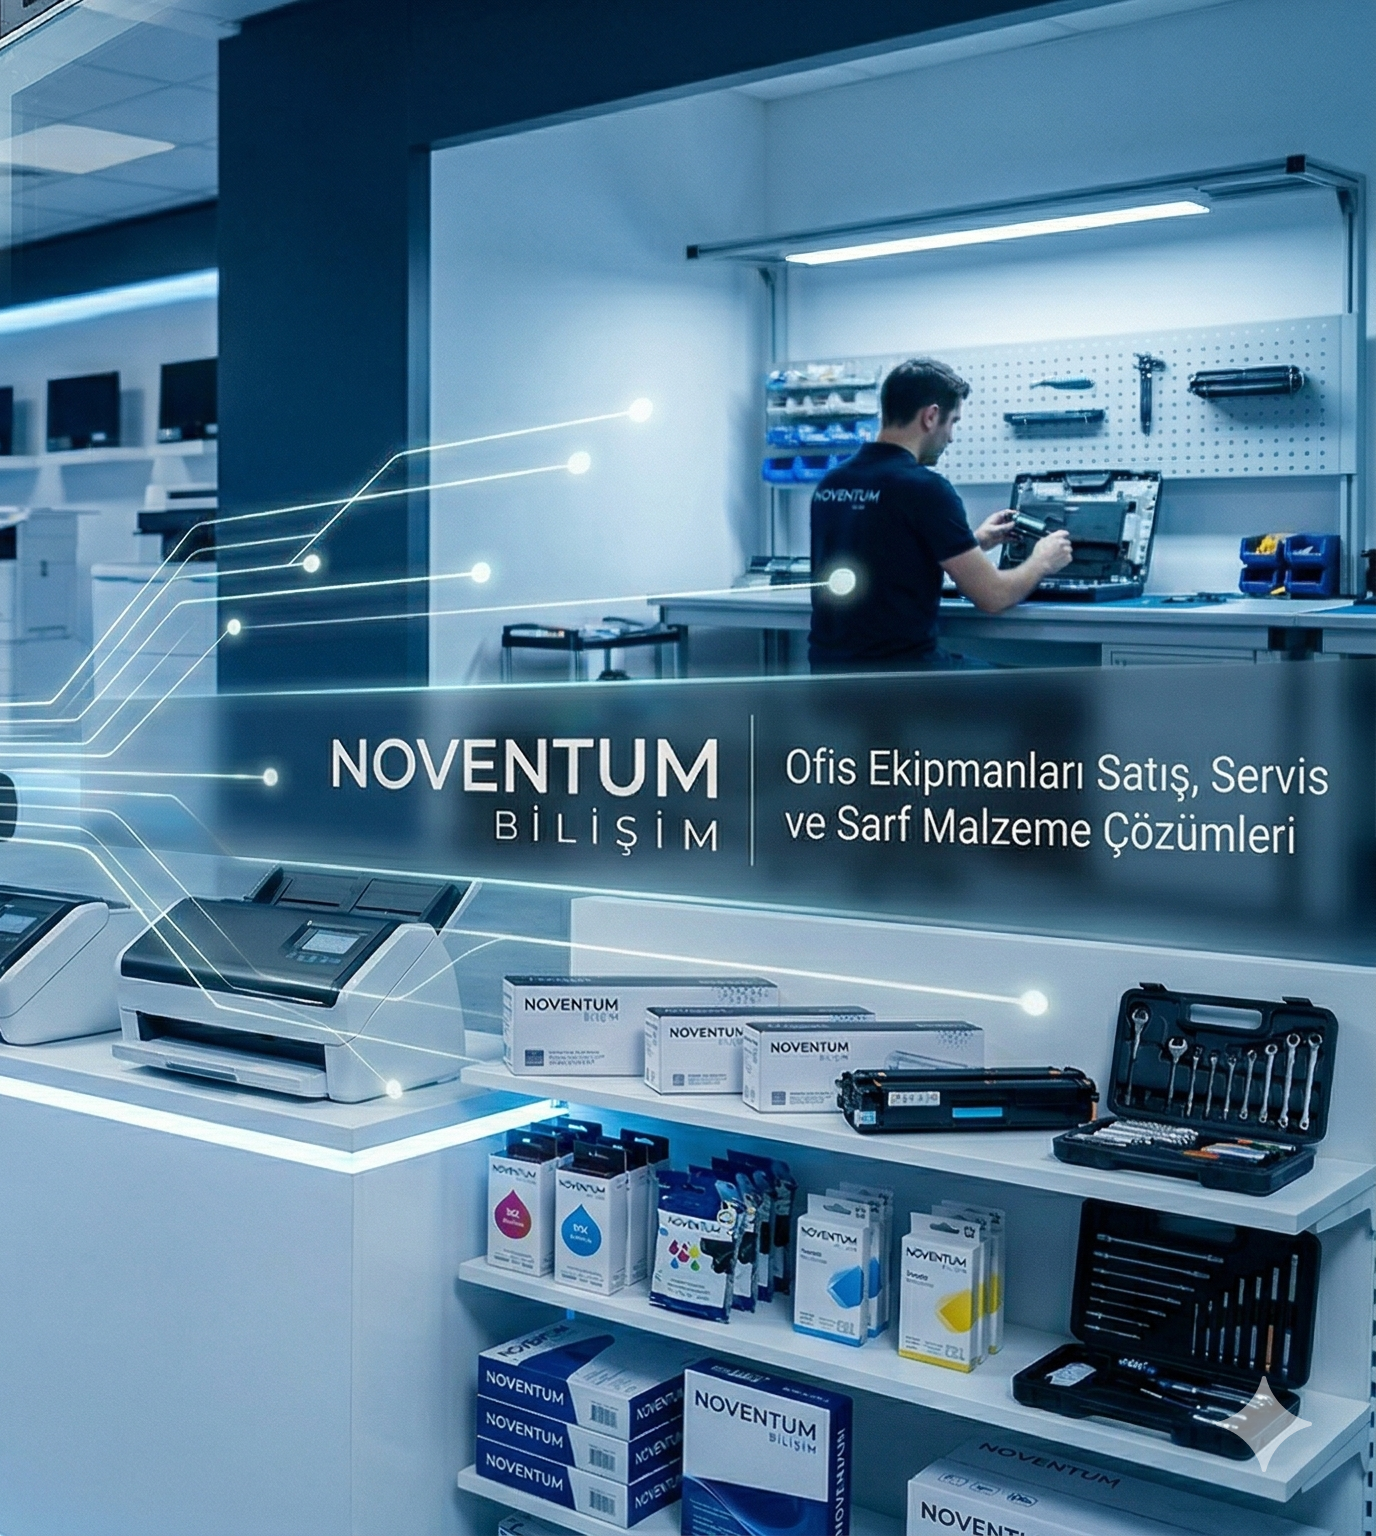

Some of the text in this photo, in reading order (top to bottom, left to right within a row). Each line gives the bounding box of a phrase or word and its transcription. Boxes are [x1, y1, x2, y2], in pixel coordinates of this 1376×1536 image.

[331, 738, 718, 799] NOVENTUM
[786, 747, 1329, 802] Ofis Ekipmanları Satış, Servis
[495, 804, 718, 857] BİLİŞİM
[784, 804, 1295, 858] ve Sarf Malzeme Çözümleri
[524, 997, 619, 1011] NOVENTUM
[770, 1041, 849, 1054] NOVENTUM
[485, 1369, 565, 1407] NOVENTUM
[485, 1411, 564, 1449] NOVENTUM
[694, 1388, 817, 1442] NOVENTUM
[485, 1452, 564, 1492] NOVENTUM
[978, 1441, 1122, 1490] NOVENTUM
